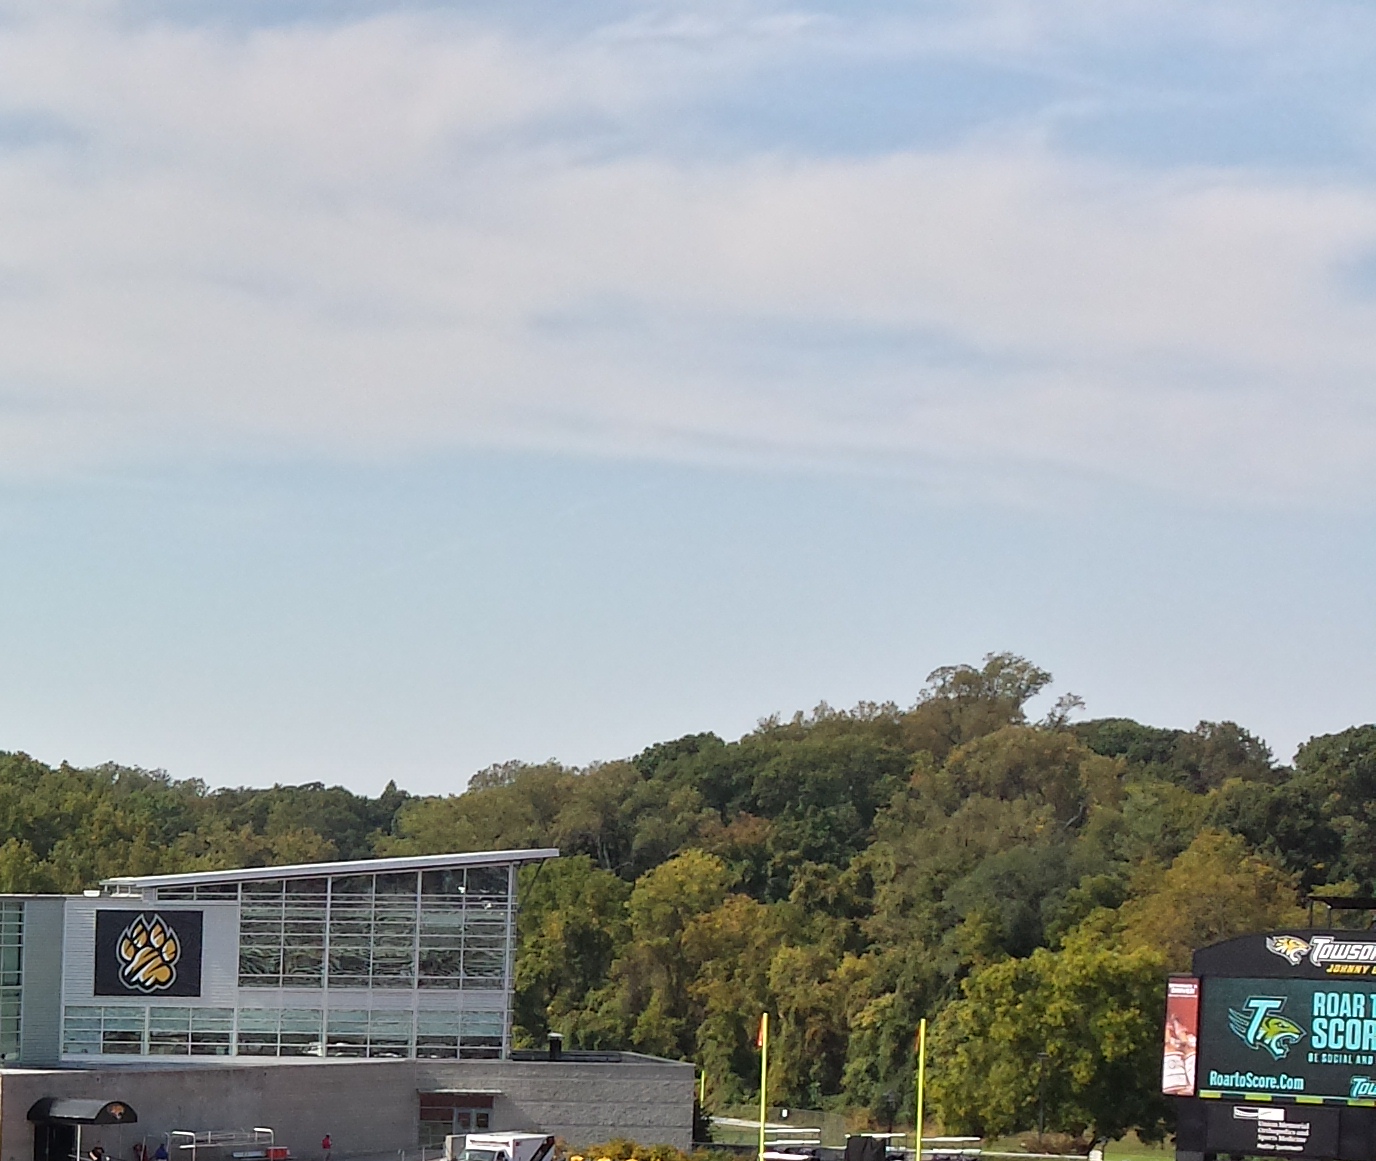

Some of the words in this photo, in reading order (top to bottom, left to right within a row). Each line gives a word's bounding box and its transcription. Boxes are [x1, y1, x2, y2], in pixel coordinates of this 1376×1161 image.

[1313, 992, 1365, 1018] ROAR
[1311, 1018, 1376, 1050] SCOR
[1209, 1070, 1304, 1090] RoartoScore.Com
